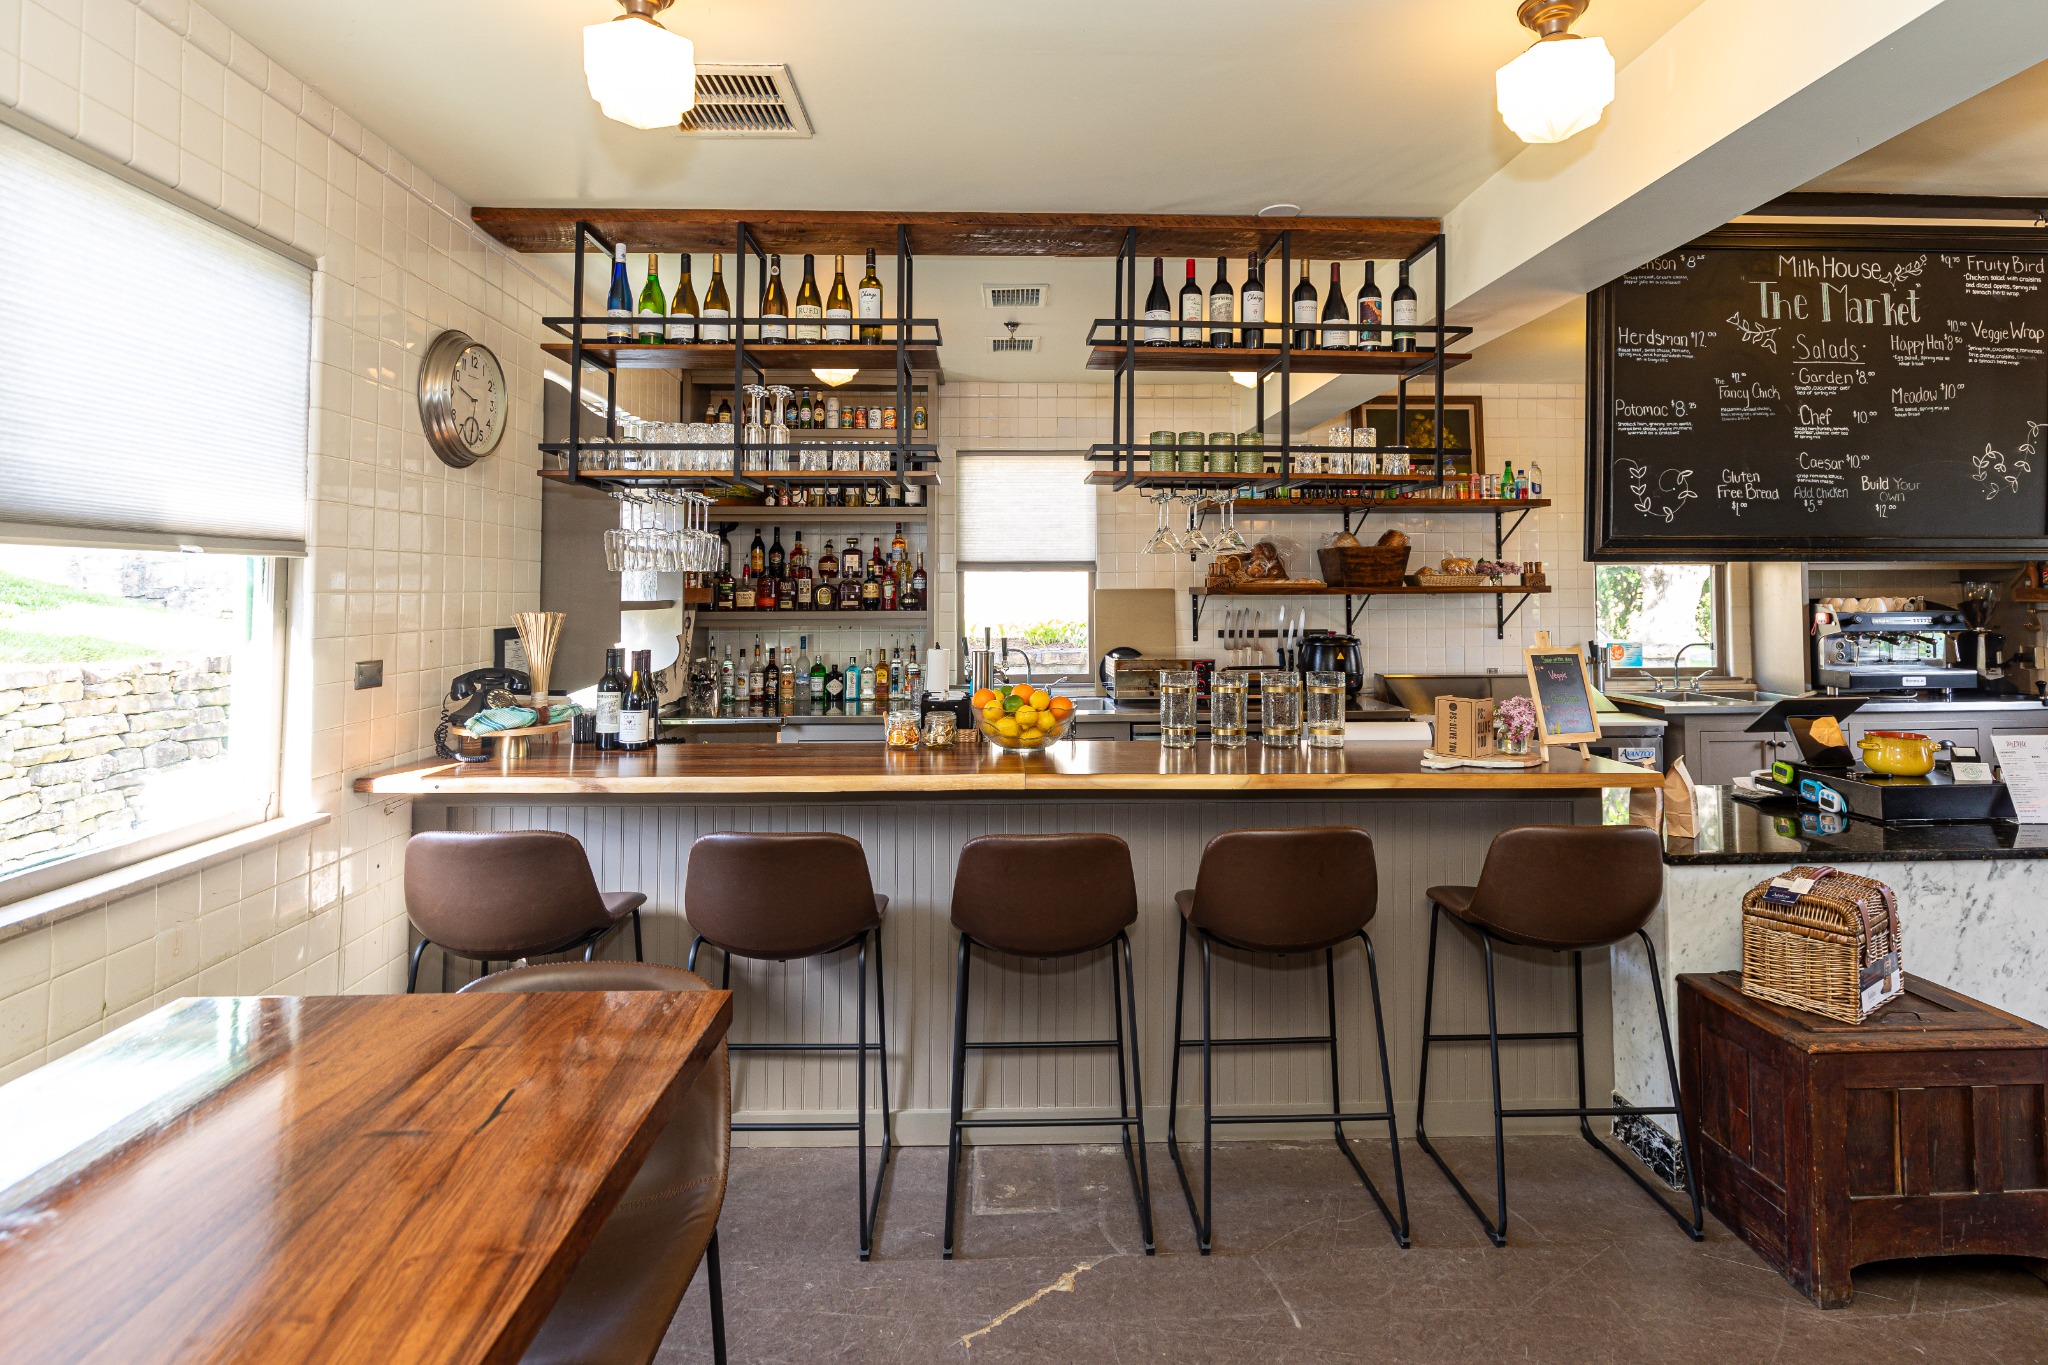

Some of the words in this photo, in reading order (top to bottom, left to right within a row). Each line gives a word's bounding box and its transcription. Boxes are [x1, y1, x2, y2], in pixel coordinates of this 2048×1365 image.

[1967, 255, 2010, 274] Fruity
[2012, 255, 2045, 273] Bird
[1619, 327, 1688, 347] Herdsman
[1971, 320, 2009, 344] Veggie
[2010, 321, 2045, 343] Wrap
[1796, 333, 1859, 361] Salads
[1891, 334, 1924, 355] Happy
[1926, 334, 1945, 351] Hen
[462, 358, 467, 371] 11
[472, 355, 479, 369] 12
[1799, 367, 1854, 385] Garden
[488, 380, 493, 392] 2
[1719, 385, 1750, 408] Fancy
[1752, 382, 1781, 400] Chick
[1891, 386, 1938, 404] Meadow
[490, 400, 494, 412] 3
[1616, 399, 1669, 416] Potomac
[452, 409, 456, 421] 8
[1800, 404, 1833, 425] Chef
[459, 423, 464, 436] 7
[486, 418, 491, 428] 4
[479, 429, 483, 442] 5
[1799, 451, 1845, 471] Caesar
[1722, 468, 1760, 484] Gluten
[1861, 475, 1890, 491] Build
[1893, 477, 1921, 491] Your
[1717, 484, 1744, 499] Free
[1745, 482, 1780, 500] Bread
[1794, 485, 1815, 499] Add
[1880, 491, 1905, 503] Own
[1449, 742, 1457, 753] YOU
